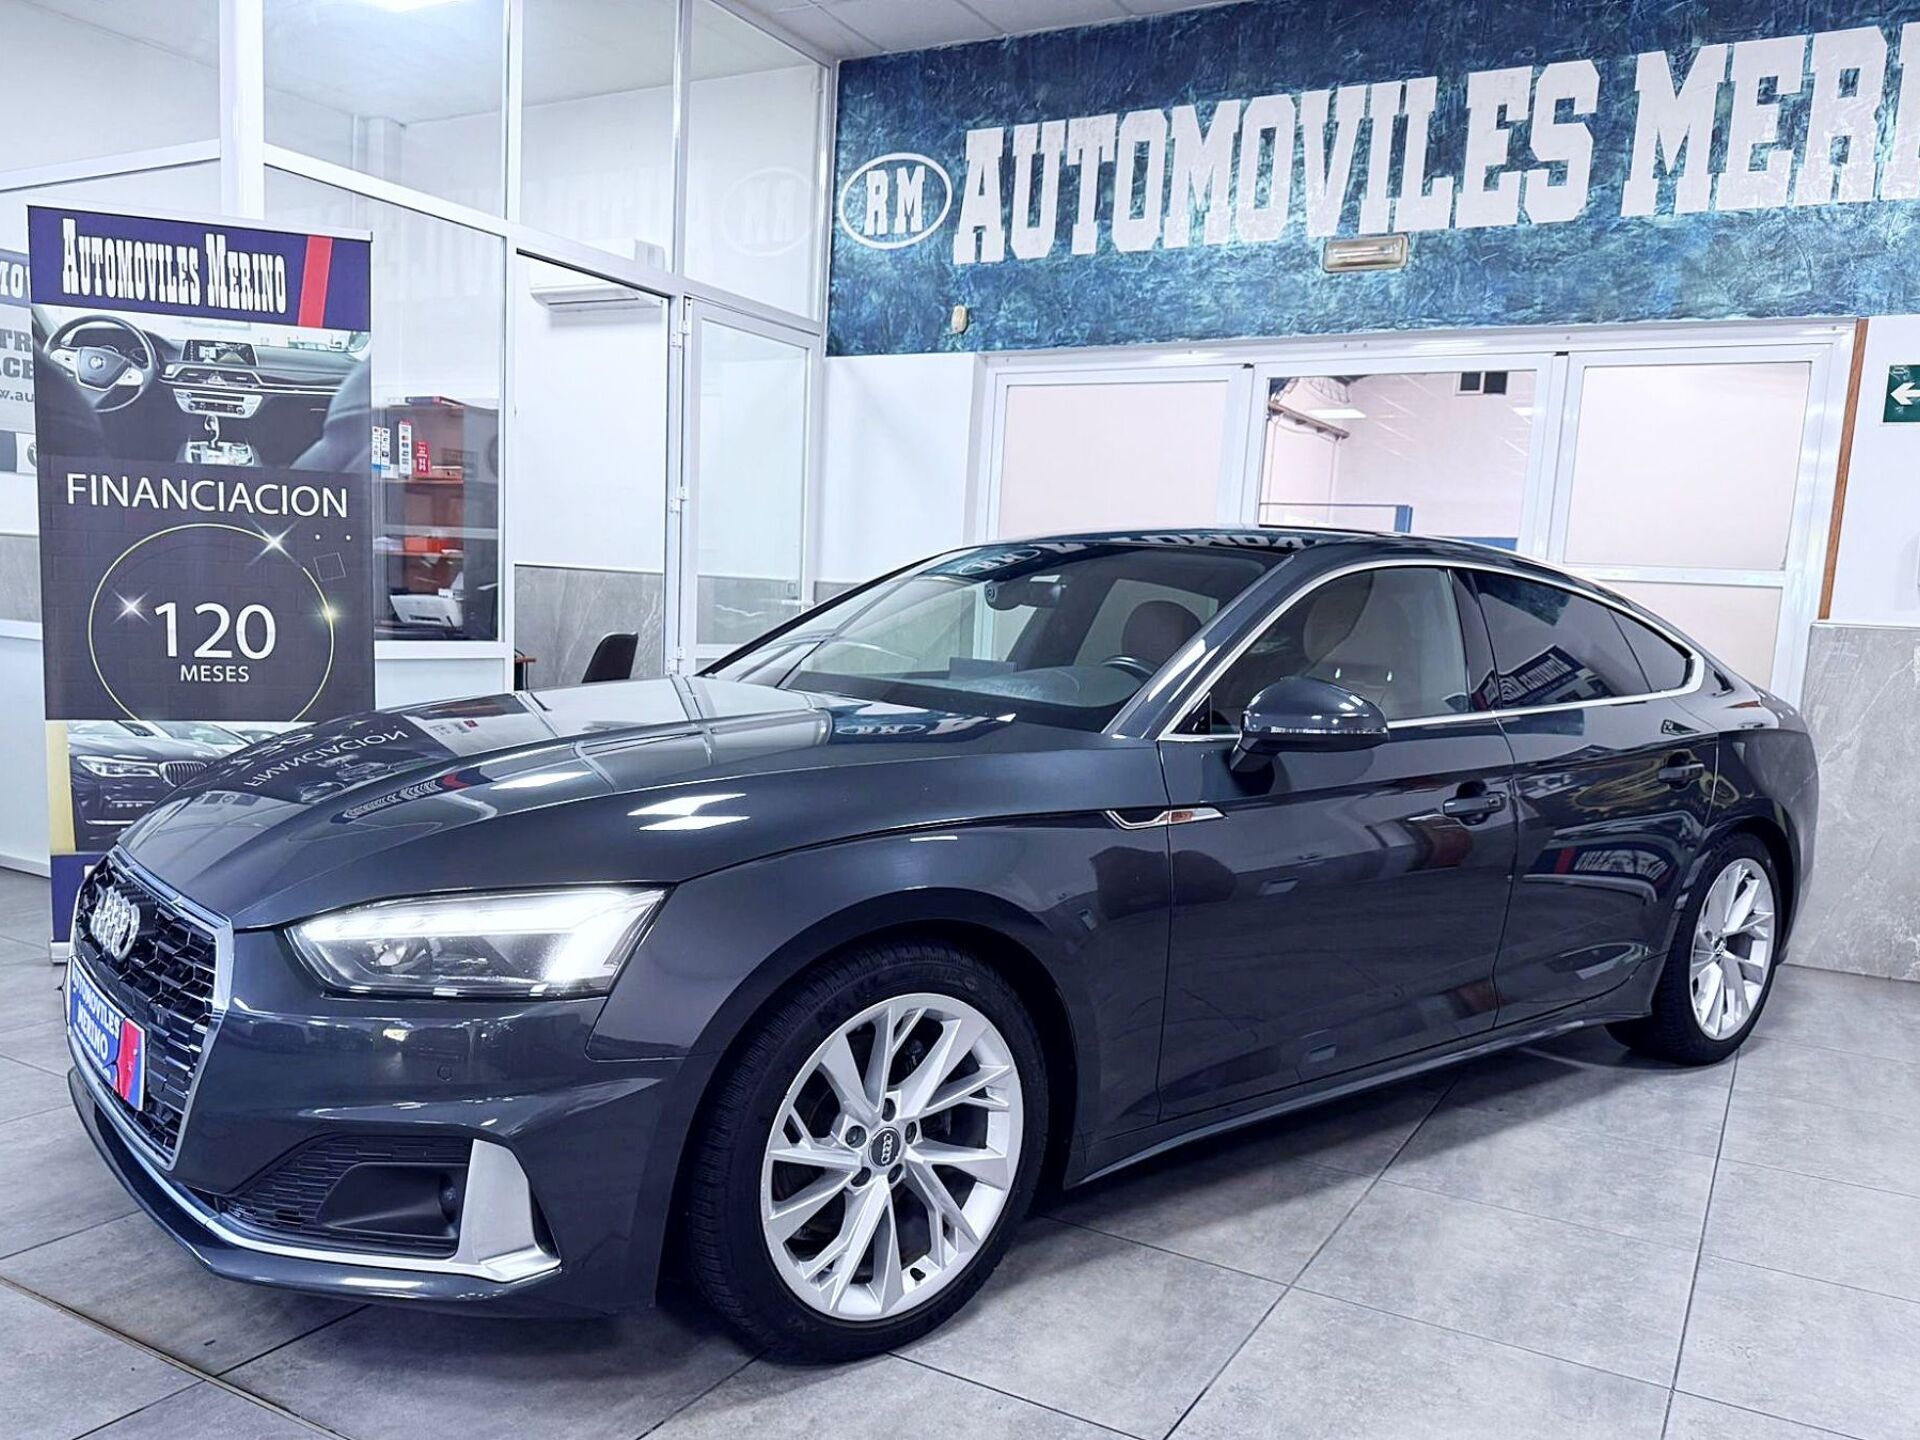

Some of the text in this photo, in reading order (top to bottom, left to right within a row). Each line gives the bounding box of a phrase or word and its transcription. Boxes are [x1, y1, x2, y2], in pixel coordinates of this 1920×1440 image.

[953, 59, 1600, 265] AUTOMOVILES
[66, 473, 349, 518] FINANCIACION
[154, 601, 277, 660] 120
[180, 664, 250, 682] MESES
